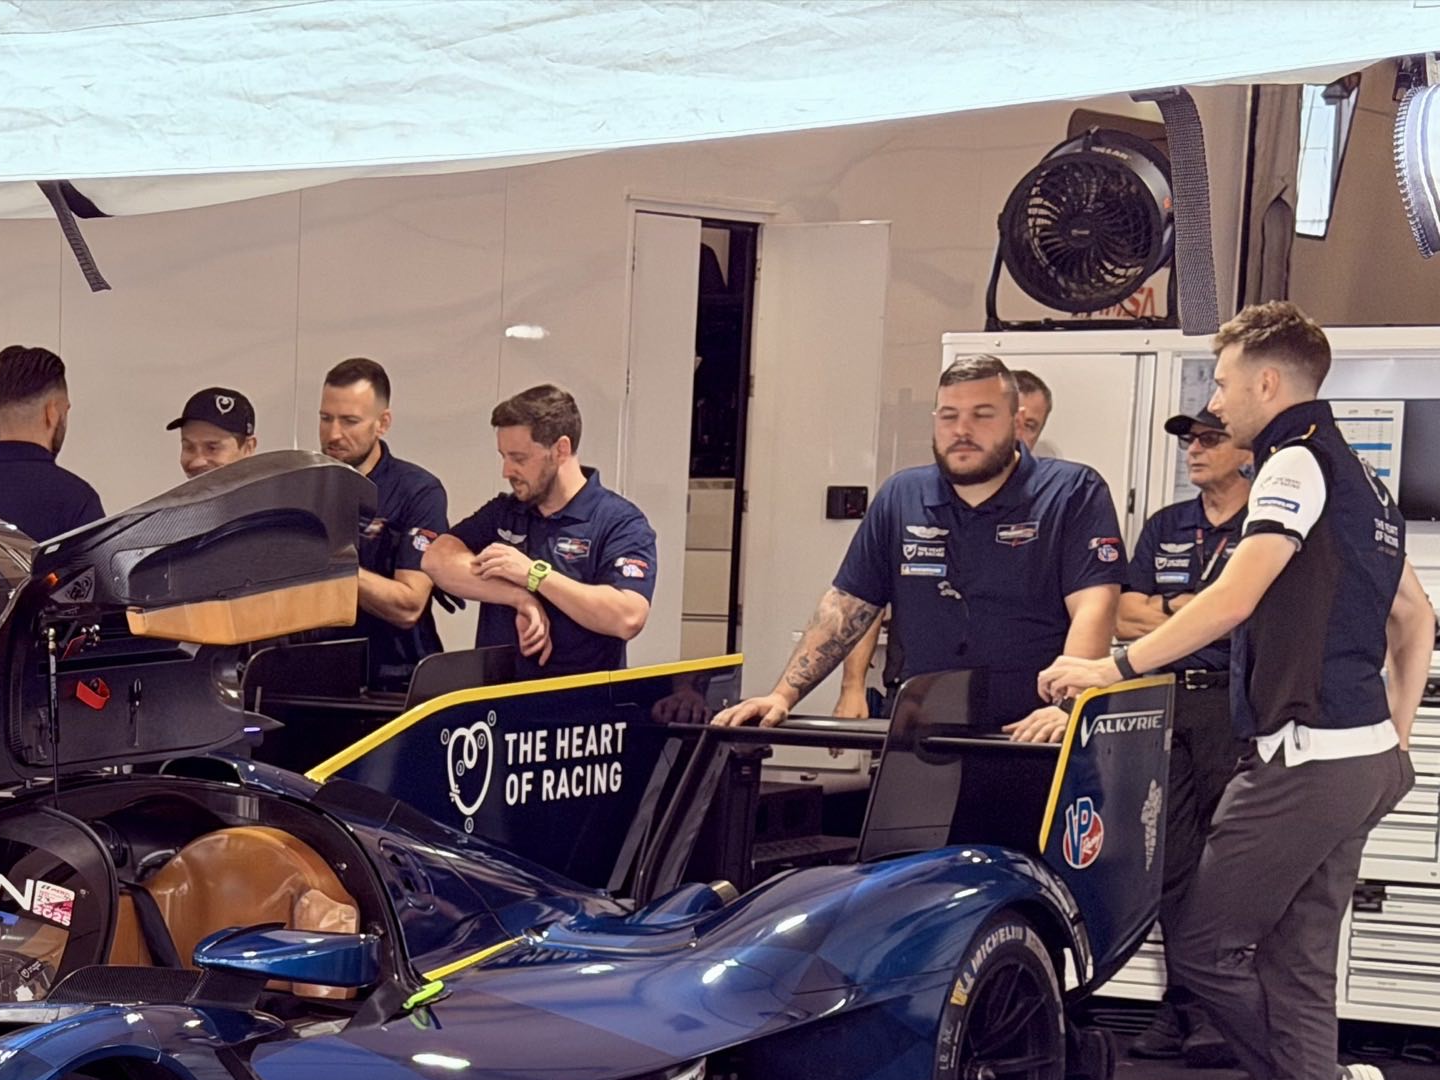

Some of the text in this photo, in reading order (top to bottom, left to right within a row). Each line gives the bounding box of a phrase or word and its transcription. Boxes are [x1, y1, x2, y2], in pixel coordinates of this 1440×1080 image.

[505, 722, 627, 765] THE HEART
[1081, 710, 1164, 748] VALKYRIE
[505, 761, 622, 806] OF RACING
